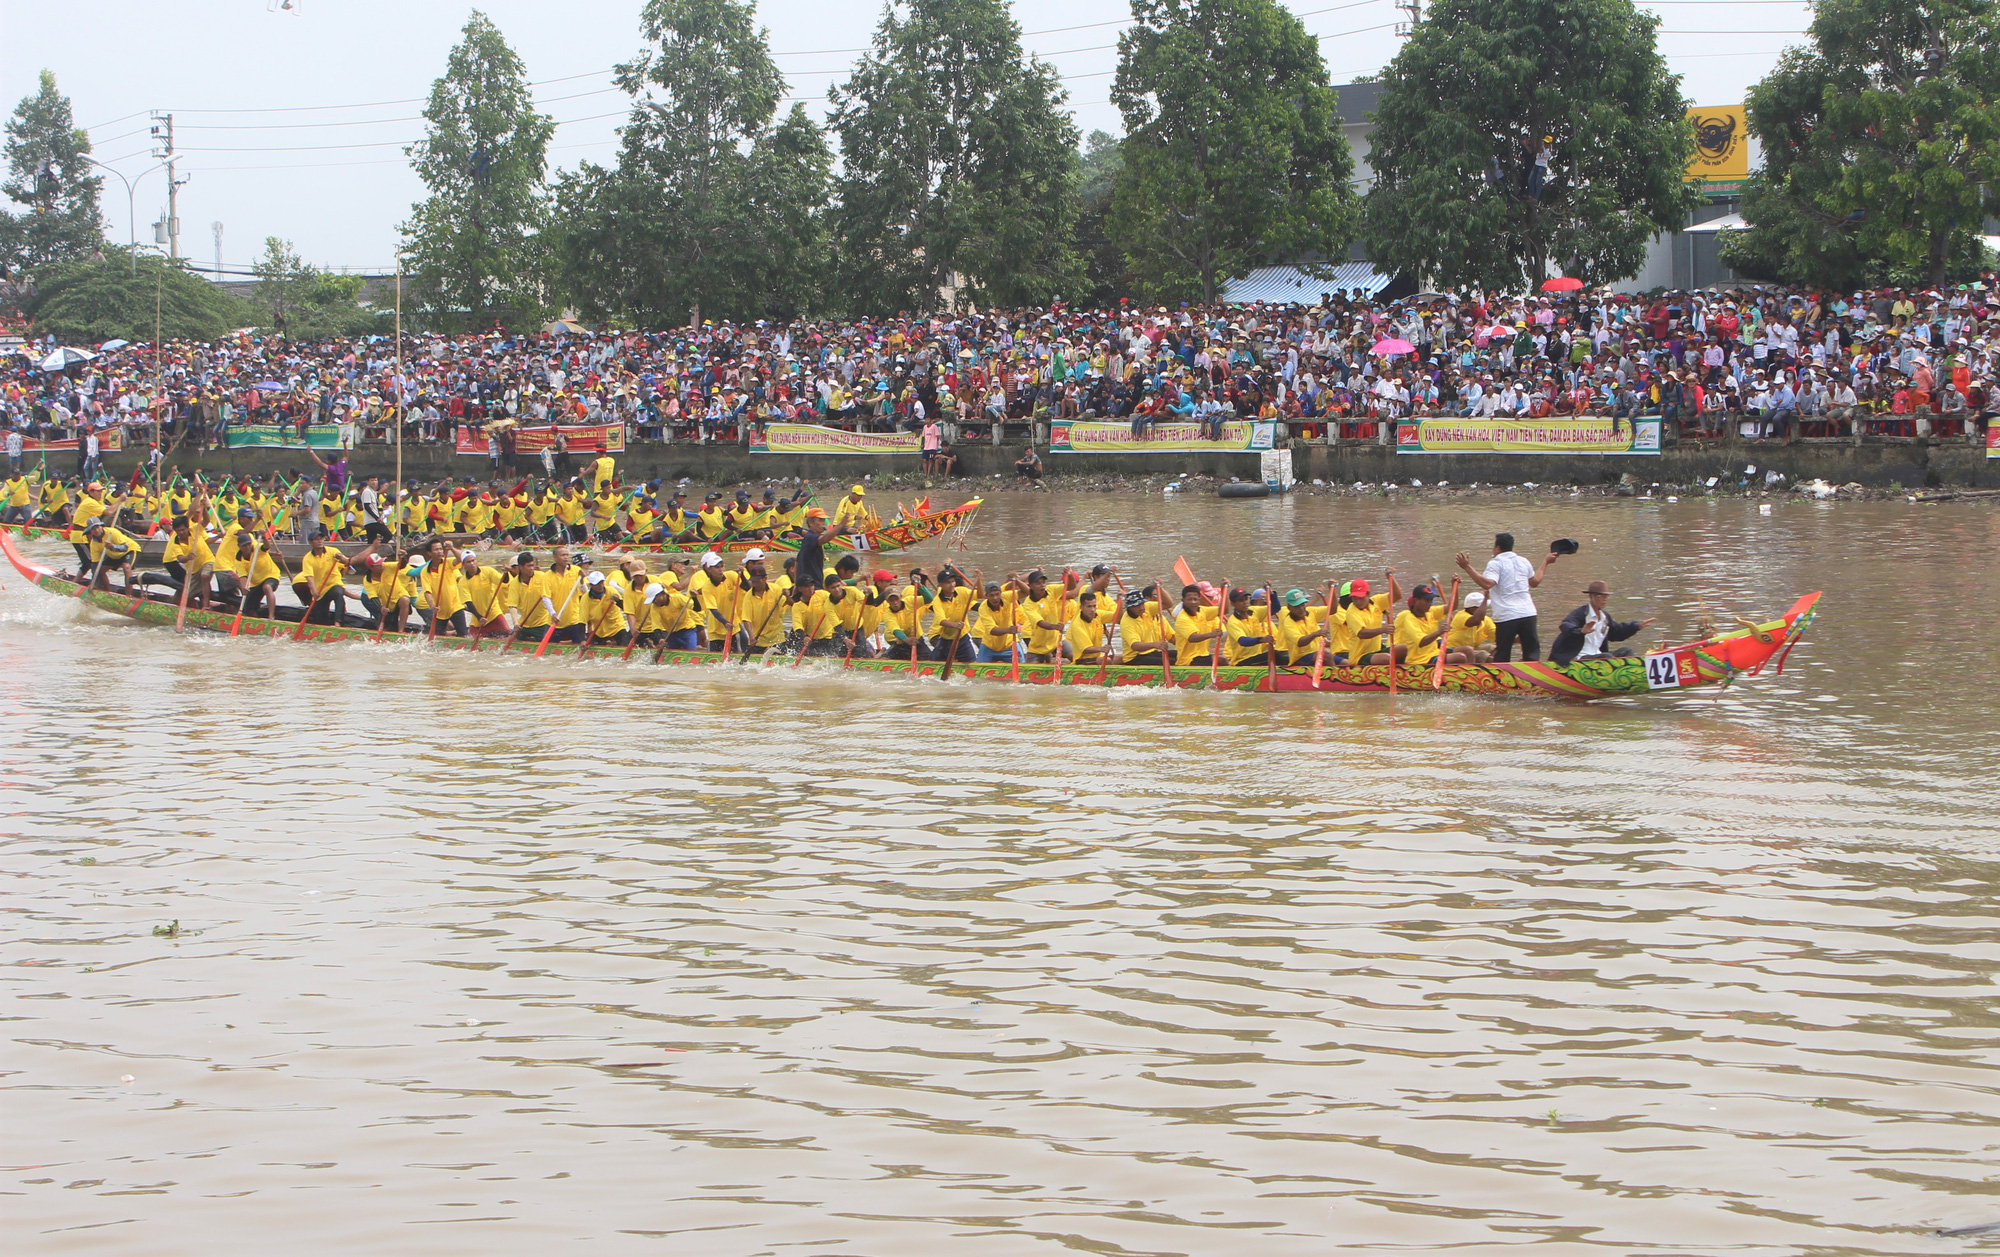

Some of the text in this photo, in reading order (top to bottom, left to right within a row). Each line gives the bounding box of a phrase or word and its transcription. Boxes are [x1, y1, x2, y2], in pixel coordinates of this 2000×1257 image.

[1506, 428, 1519, 442] NAM
[855, 535, 864, 549] 7
[1649, 656, 1676, 685] 42
